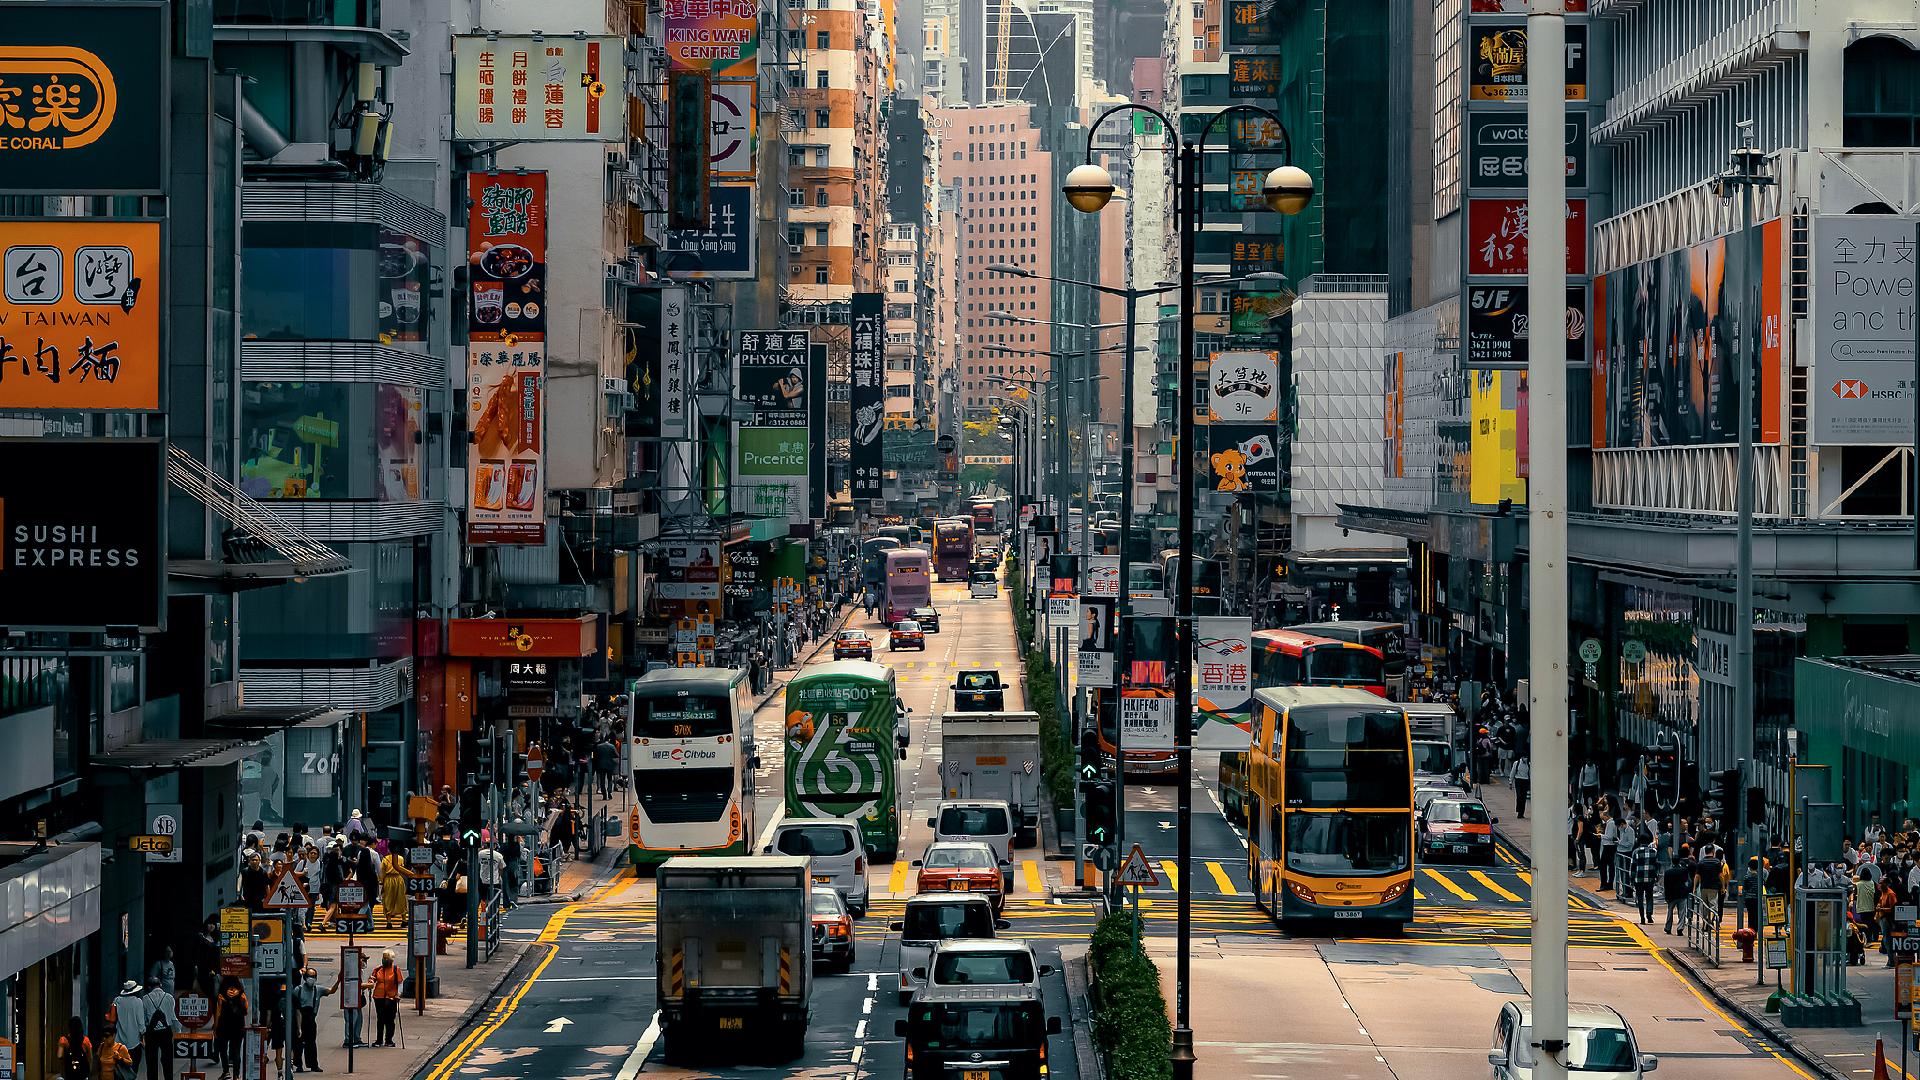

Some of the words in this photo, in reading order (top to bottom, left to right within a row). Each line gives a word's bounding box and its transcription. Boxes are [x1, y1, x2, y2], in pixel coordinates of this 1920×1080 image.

[669, 28, 710, 42] KING
[713, 29, 750, 43] WAH
[680, 46, 740, 59] CENTRE
[11, 137, 61, 149] CORAL
[681, 240, 699, 251] Chow
[701, 239, 717, 253] Sang
[720, 239, 736, 253] Sang
[1834, 271, 1913, 297] Powe
[126, 288, 134, 306] 台北
[1472, 290, 1510, 309] 5/F
[22, 312, 111, 326] TAIWAN
[1833, 305, 1884, 330] and
[741, 334, 806, 351] 舒適堡
[855, 314, 873, 388] 六福珠寶
[742, 354, 806, 365] PHYSICAL
[1872, 391, 1901, 399] HSBC
[1236, 403, 1252, 414] 3/F
[744, 452, 804, 465] Pricerite
[15, 525, 97, 543] SUSHI
[15, 549, 139, 566] EXPRESS
[510, 664, 547, 675] 周大福
[1202, 664, 1247, 683] 香港
[1124, 699, 1159, 711] HKIFF48
[684, 750, 716, 759] Citybus
[409, 878, 433, 890] S13
[337, 920, 365, 932] S12
[1892, 937, 1919, 951] N66
[176, 1041, 208, 1057] S11
